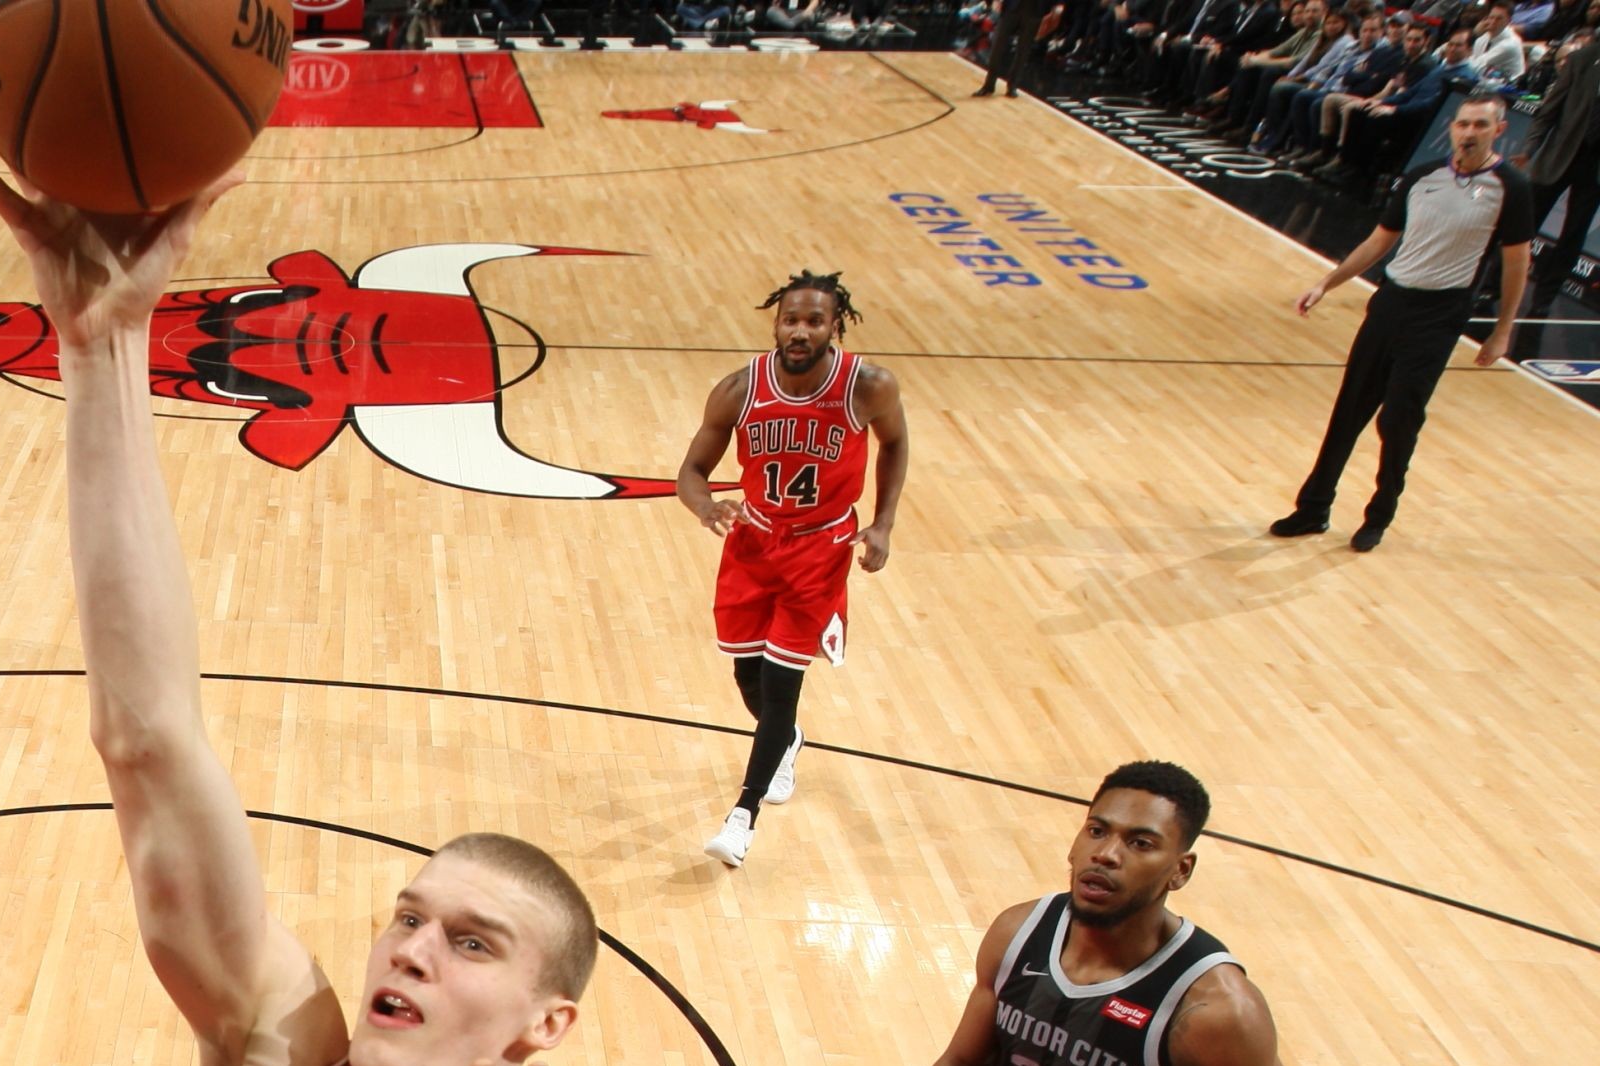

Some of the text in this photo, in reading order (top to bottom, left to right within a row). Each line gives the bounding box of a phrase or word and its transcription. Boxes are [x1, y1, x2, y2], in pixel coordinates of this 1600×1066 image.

[888, 192, 1043, 287] CENTER
[976, 193, 1149, 289] UNITED
[746, 417, 846, 463] BULLS
[763, 461, 821, 508] 14
[995, 1000, 1069, 1057] MOTOR
[1108, 999, 1147, 1020] Flagstar
